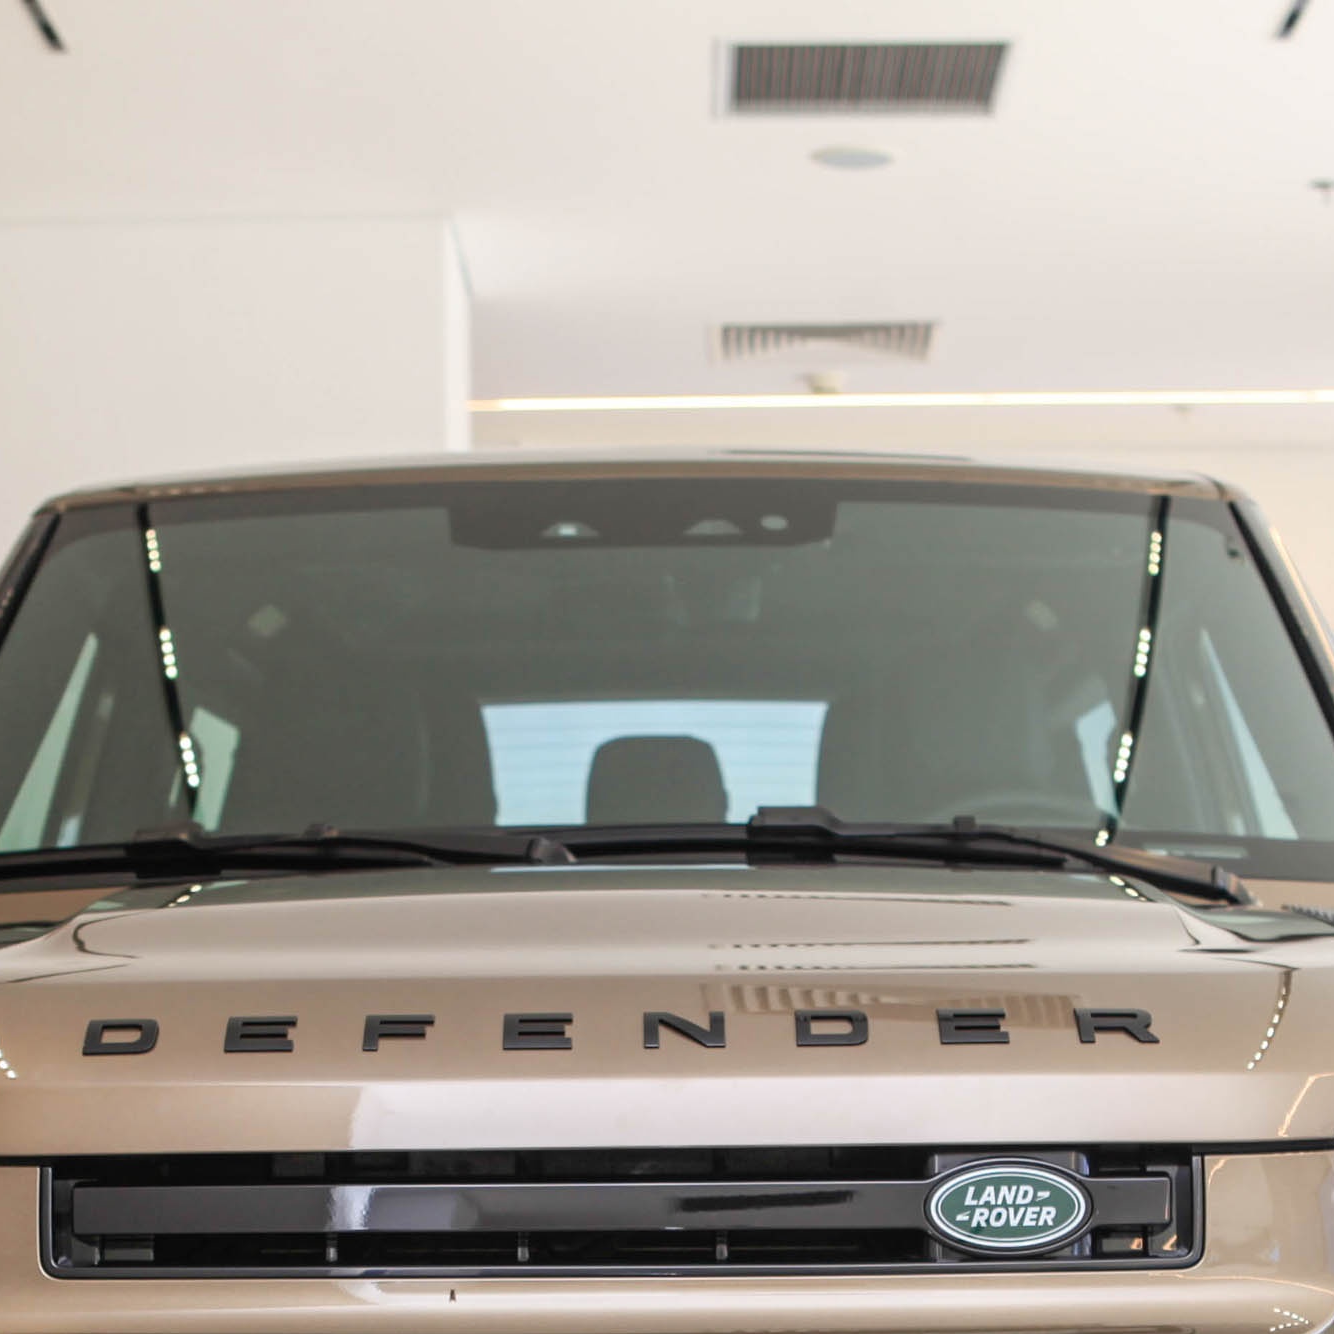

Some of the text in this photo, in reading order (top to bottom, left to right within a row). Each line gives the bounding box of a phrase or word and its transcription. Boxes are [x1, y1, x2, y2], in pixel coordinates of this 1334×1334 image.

[82, 1007, 1160, 1056] DEFENDER
[964, 1185, 1034, 1206] LAND
[971, 1206, 1056, 1228] ROVER
